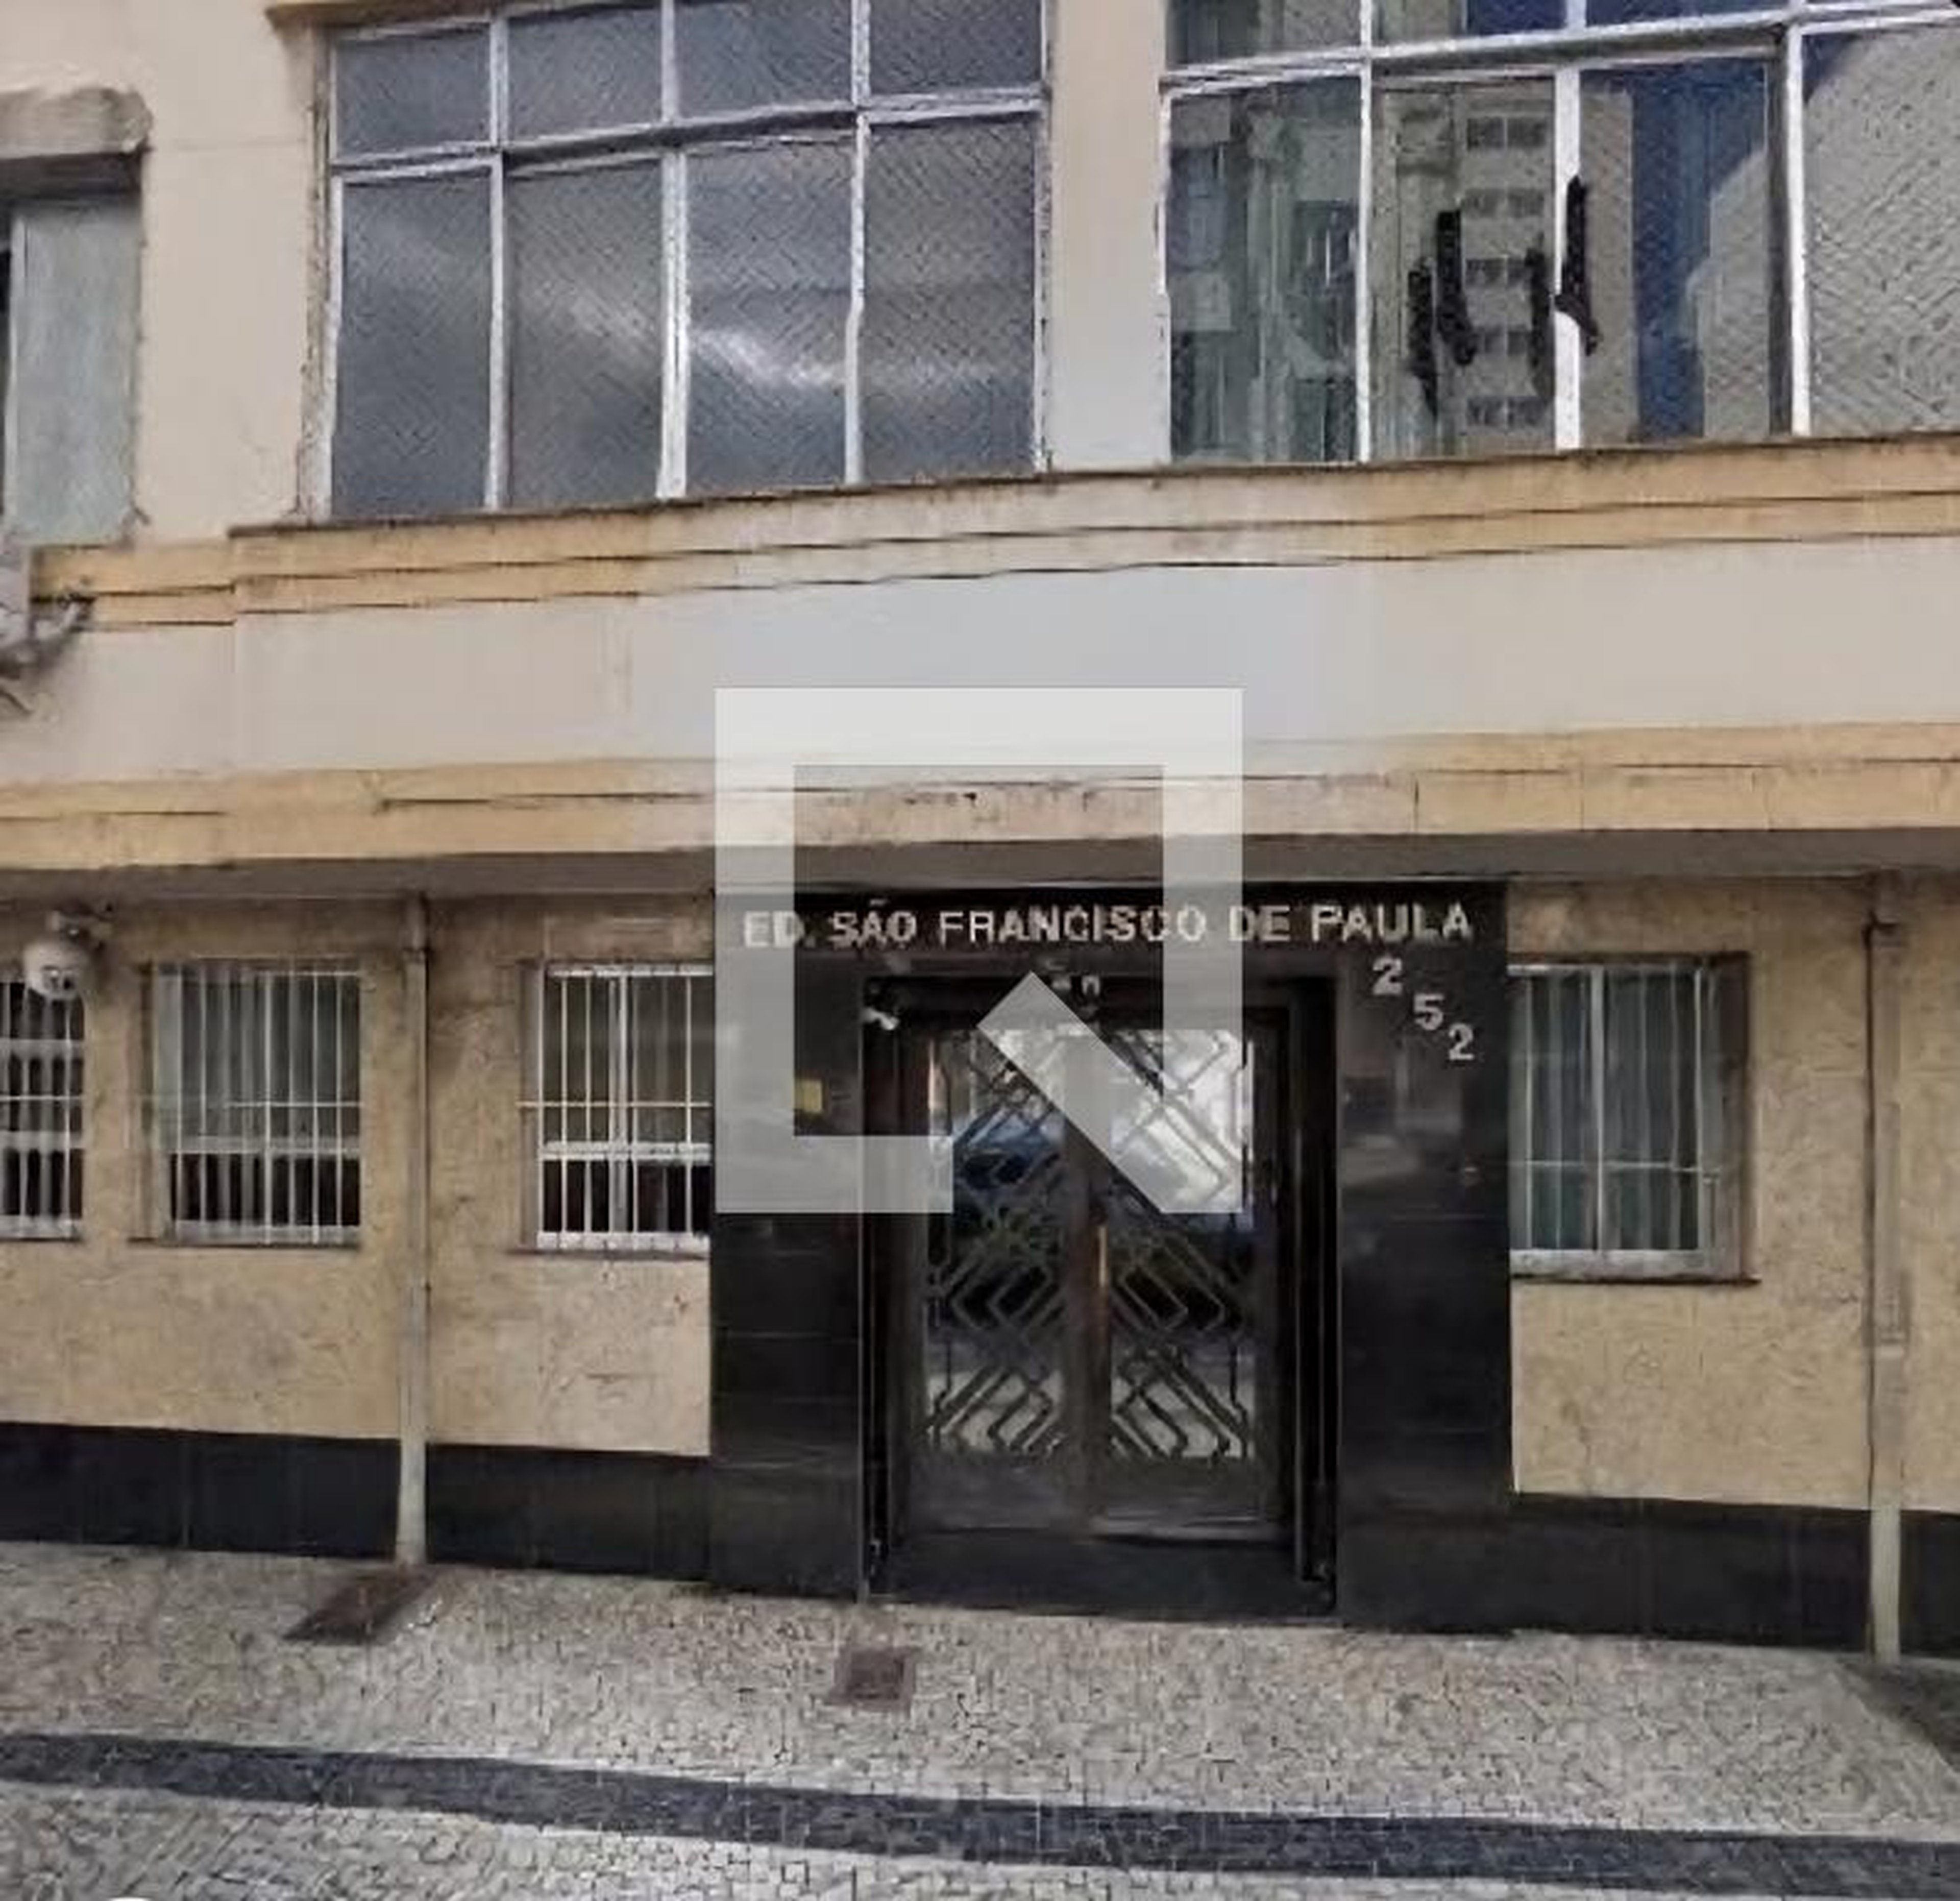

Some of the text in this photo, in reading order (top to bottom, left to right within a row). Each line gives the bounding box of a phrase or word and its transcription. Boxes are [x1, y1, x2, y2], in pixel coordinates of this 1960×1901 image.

[827, 898, 917, 948] SÃO
[938, 904, 1207, 946] FRANCISCO
[1228, 905, 1291, 942] DE
[1311, 902, 1473, 942] PAULA
